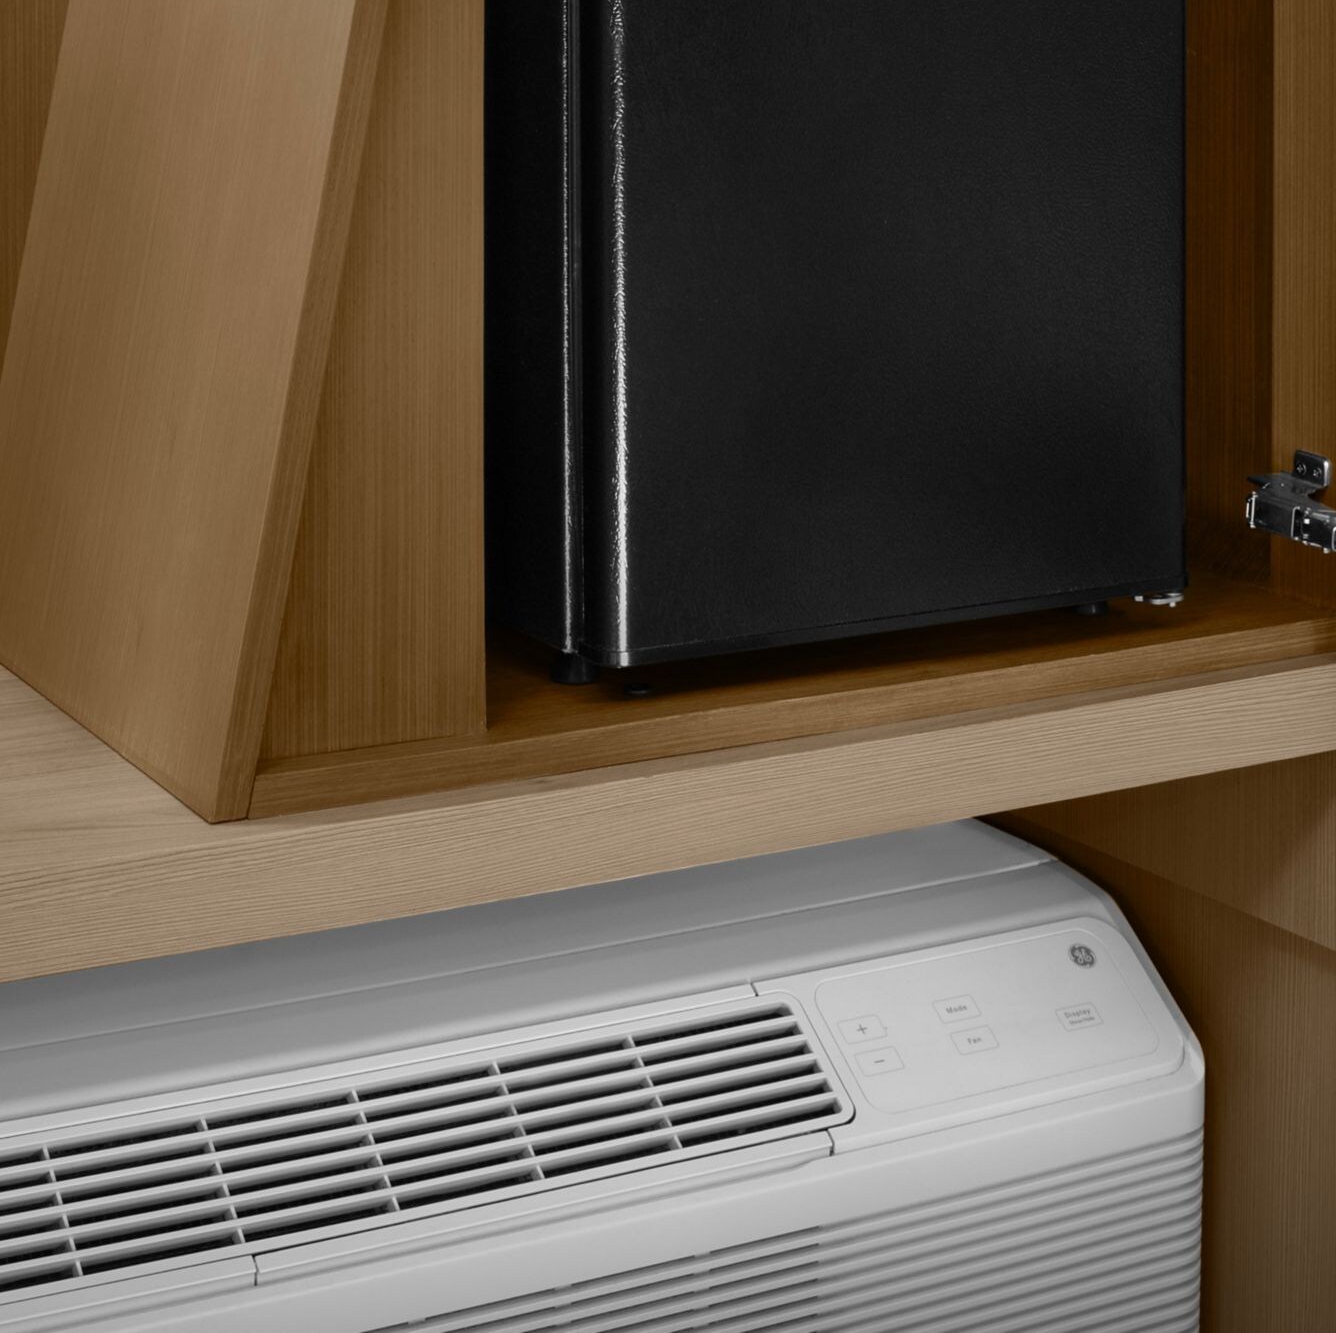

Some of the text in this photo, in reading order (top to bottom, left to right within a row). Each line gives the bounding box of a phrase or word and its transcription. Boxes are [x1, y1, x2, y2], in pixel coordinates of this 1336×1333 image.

[945, 1005, 968, 1014] Mode
[1064, 1009, 1091, 1020] Display
[967, 1037, 982, 1045] Fan
